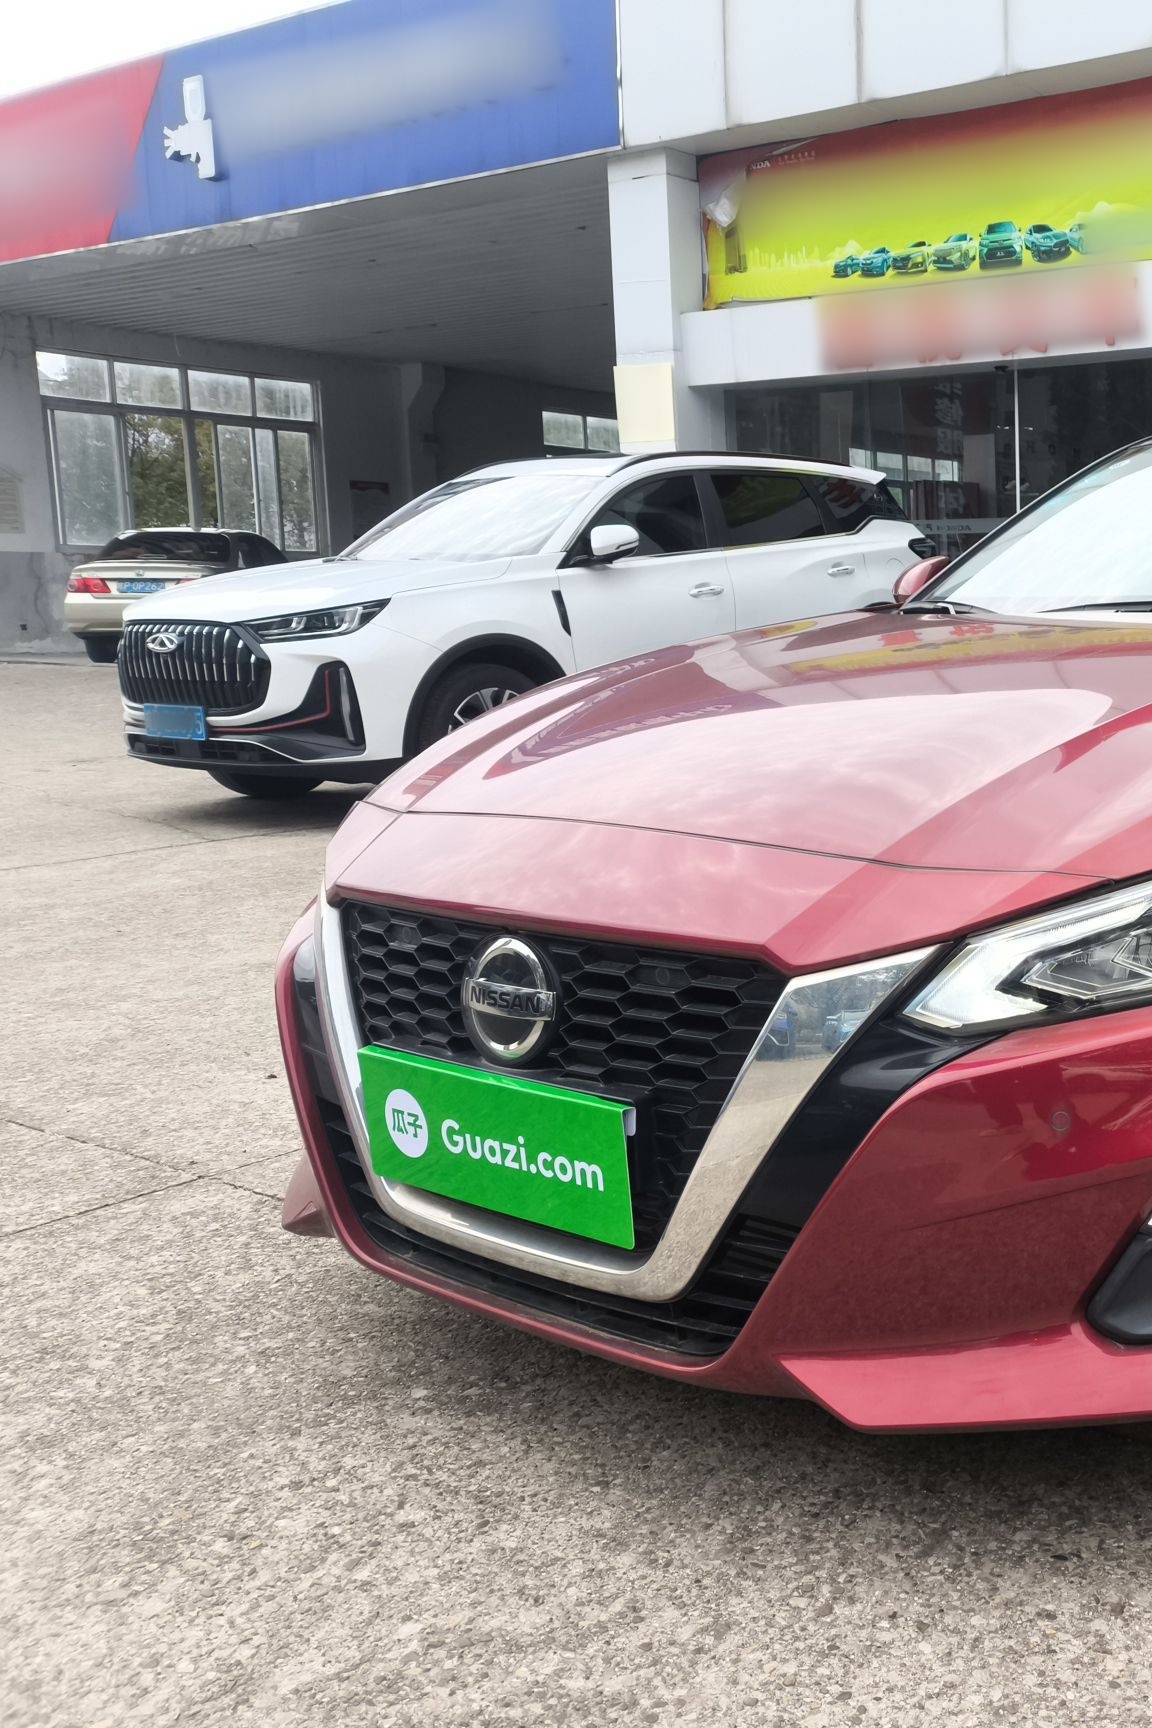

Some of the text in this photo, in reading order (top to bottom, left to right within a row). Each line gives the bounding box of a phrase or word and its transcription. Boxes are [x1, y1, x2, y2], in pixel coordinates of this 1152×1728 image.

[471, 985, 541, 1013] NISSAN
[391, 1107, 423, 1139] 瓜子
[441, 1118, 604, 1192] Guazi.com
